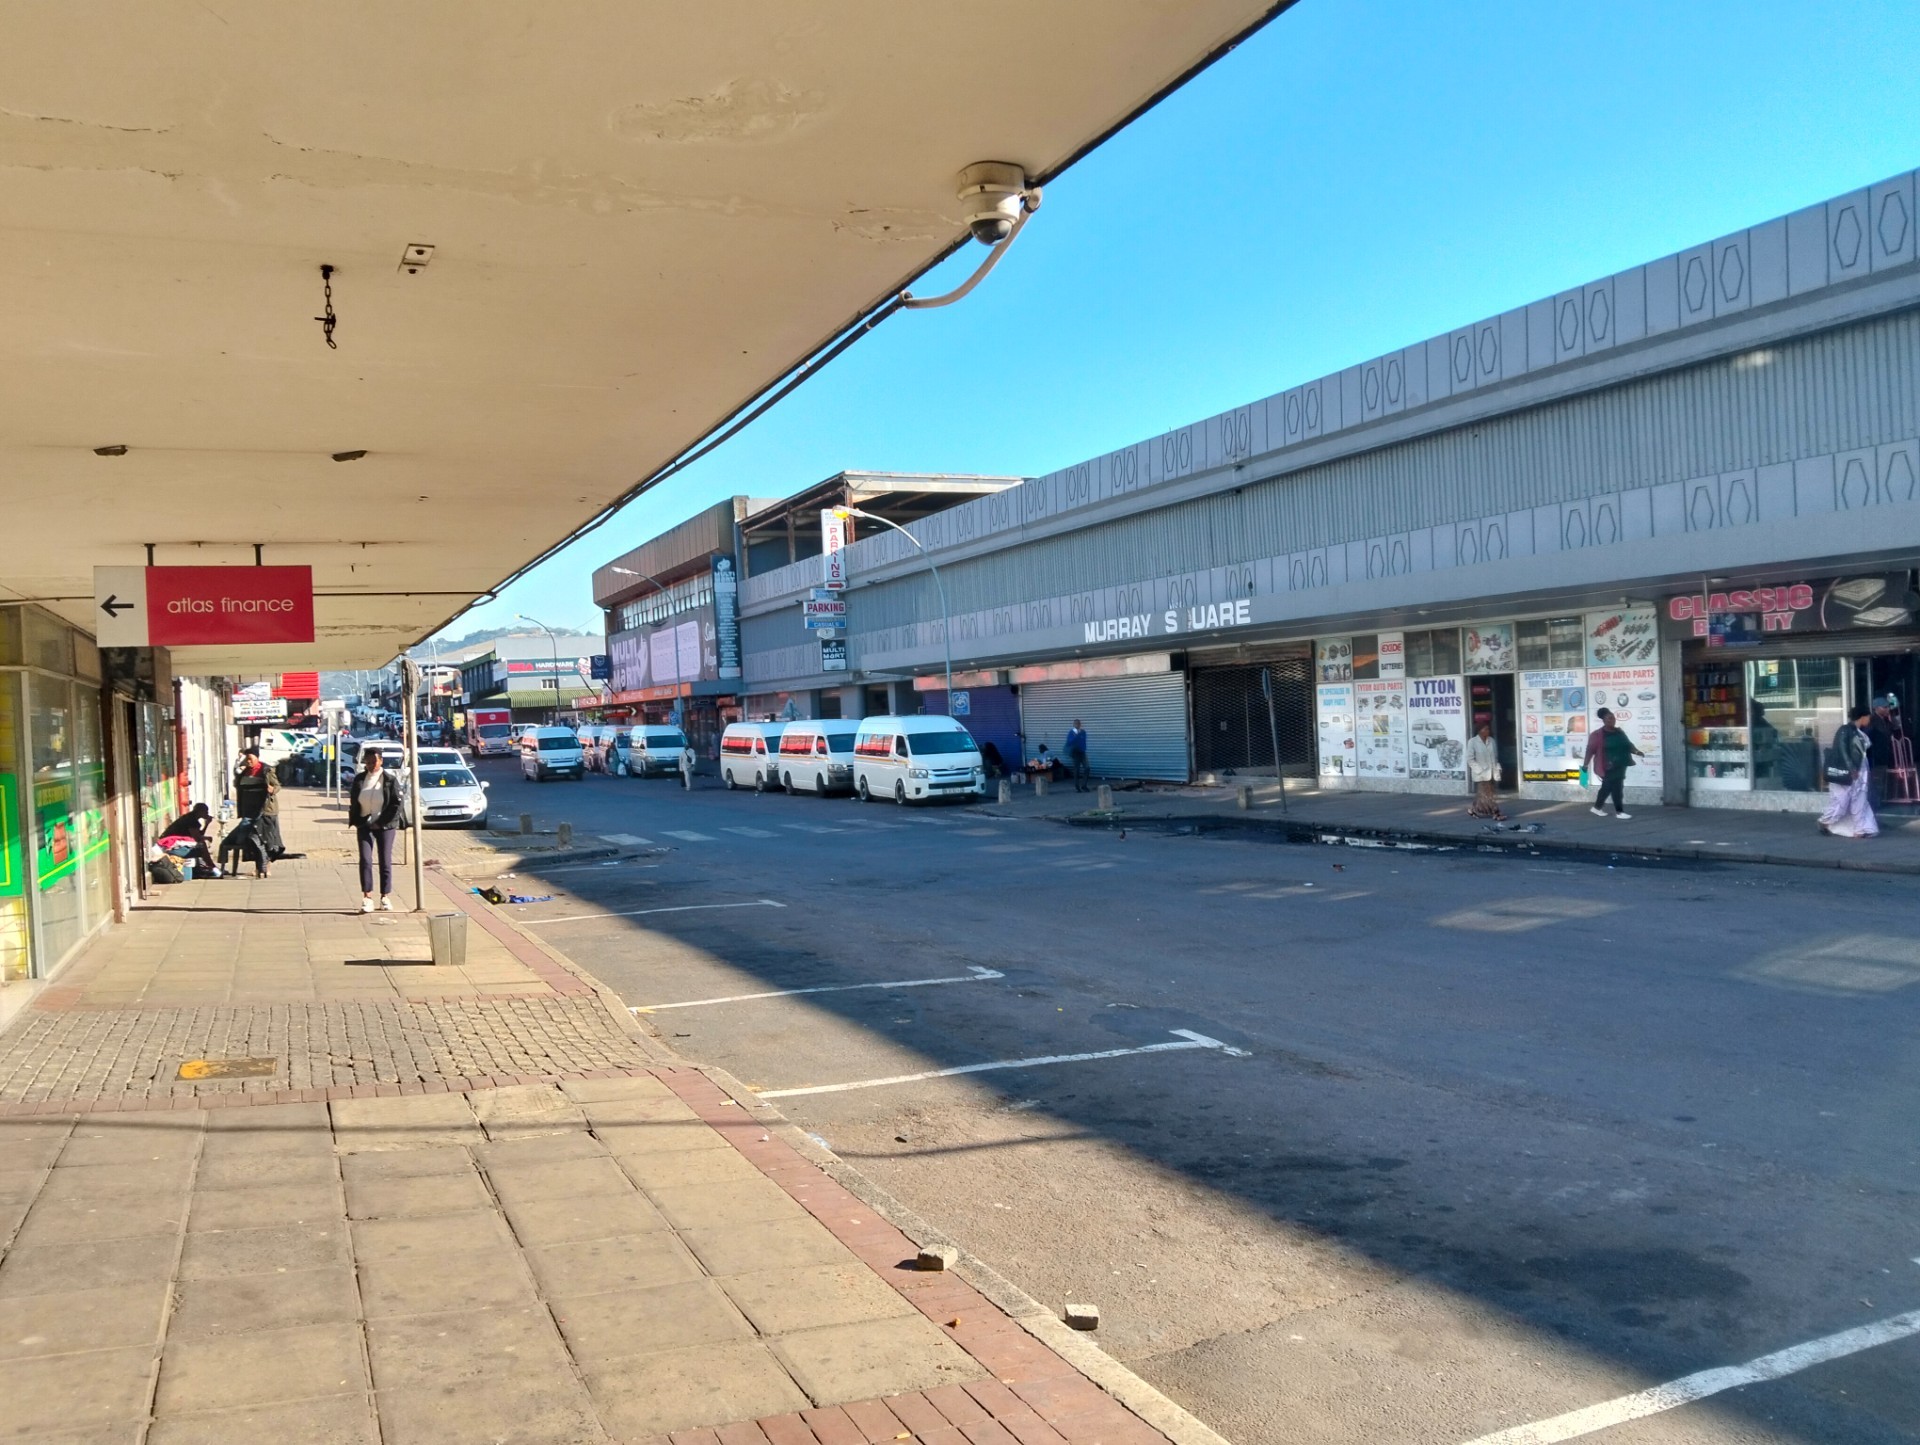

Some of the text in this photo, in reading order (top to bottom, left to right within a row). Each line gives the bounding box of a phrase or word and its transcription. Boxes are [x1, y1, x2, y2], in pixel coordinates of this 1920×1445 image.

[829, 527, 841, 578] PARKING
[167, 597, 295, 614] atlas finance
[807, 603, 845, 613] PARKING
[1669, 583, 1814, 621] CLASSIC
[1084, 613, 1152, 643] MURRAY
[1380, 642, 1403, 653] EXIDE
[1380, 662, 1404, 671] BATTERIES
[1524, 671, 1578, 681] SUPPLIERS OF ALL
[1589, 669, 1655, 681] TYTON AUTO PARTS
[1357, 682, 1403, 692] TYTON AUTO PARTS
[1414, 679, 1456, 695] TYTON
[1528, 679, 1574, 688] MOTOR SPARES
[1409, 697, 1432, 708] AUTO
[1433, 696, 1462, 708] PARTS
